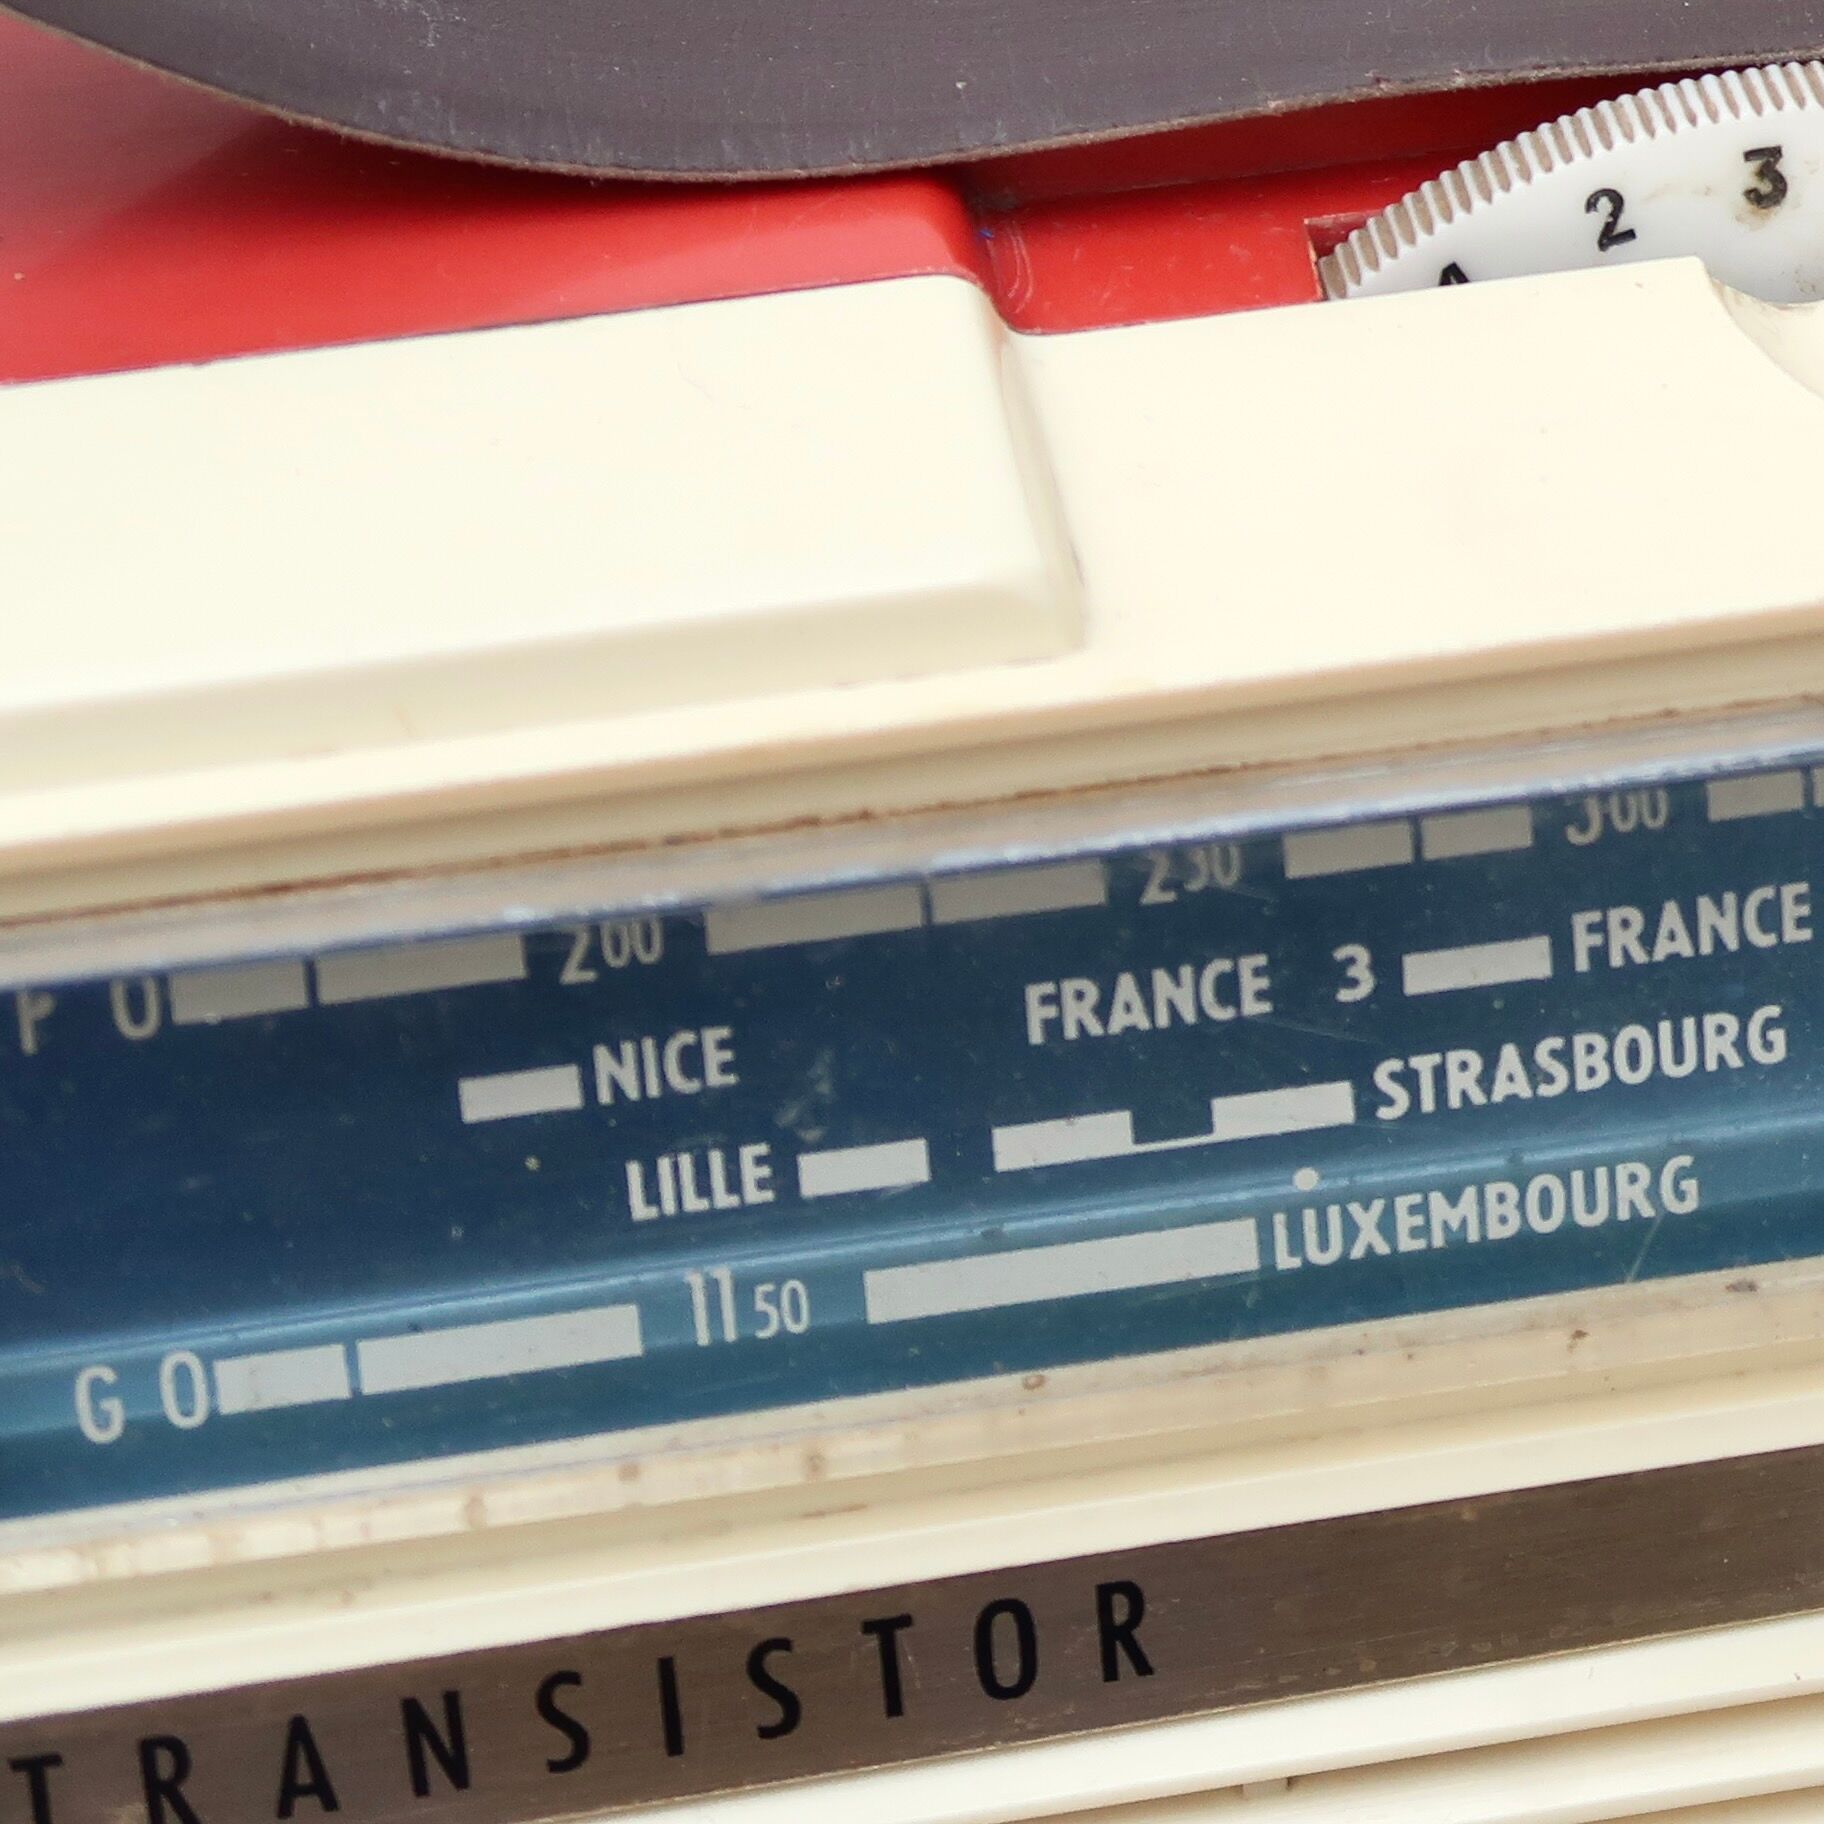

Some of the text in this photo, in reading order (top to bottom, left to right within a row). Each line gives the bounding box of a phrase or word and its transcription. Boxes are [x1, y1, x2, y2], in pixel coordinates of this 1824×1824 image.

[1585, 188, 1637, 252] 2
[1743, 145, 1788, 209] 3
[1572, 882, 1812, 972] FRANCE
[1026, 944, 1375, 1044] FRANCE 3
[593, 1027, 739, 1105] NICE
[1374, 1006, 1787, 1120] STRASBOURG
[626, 1142, 774, 1222] LILLE
[1274, 1156, 1699, 1270] LUXEMBOURG
[9, 1580, 1155, 1824] TRANSISTOR
